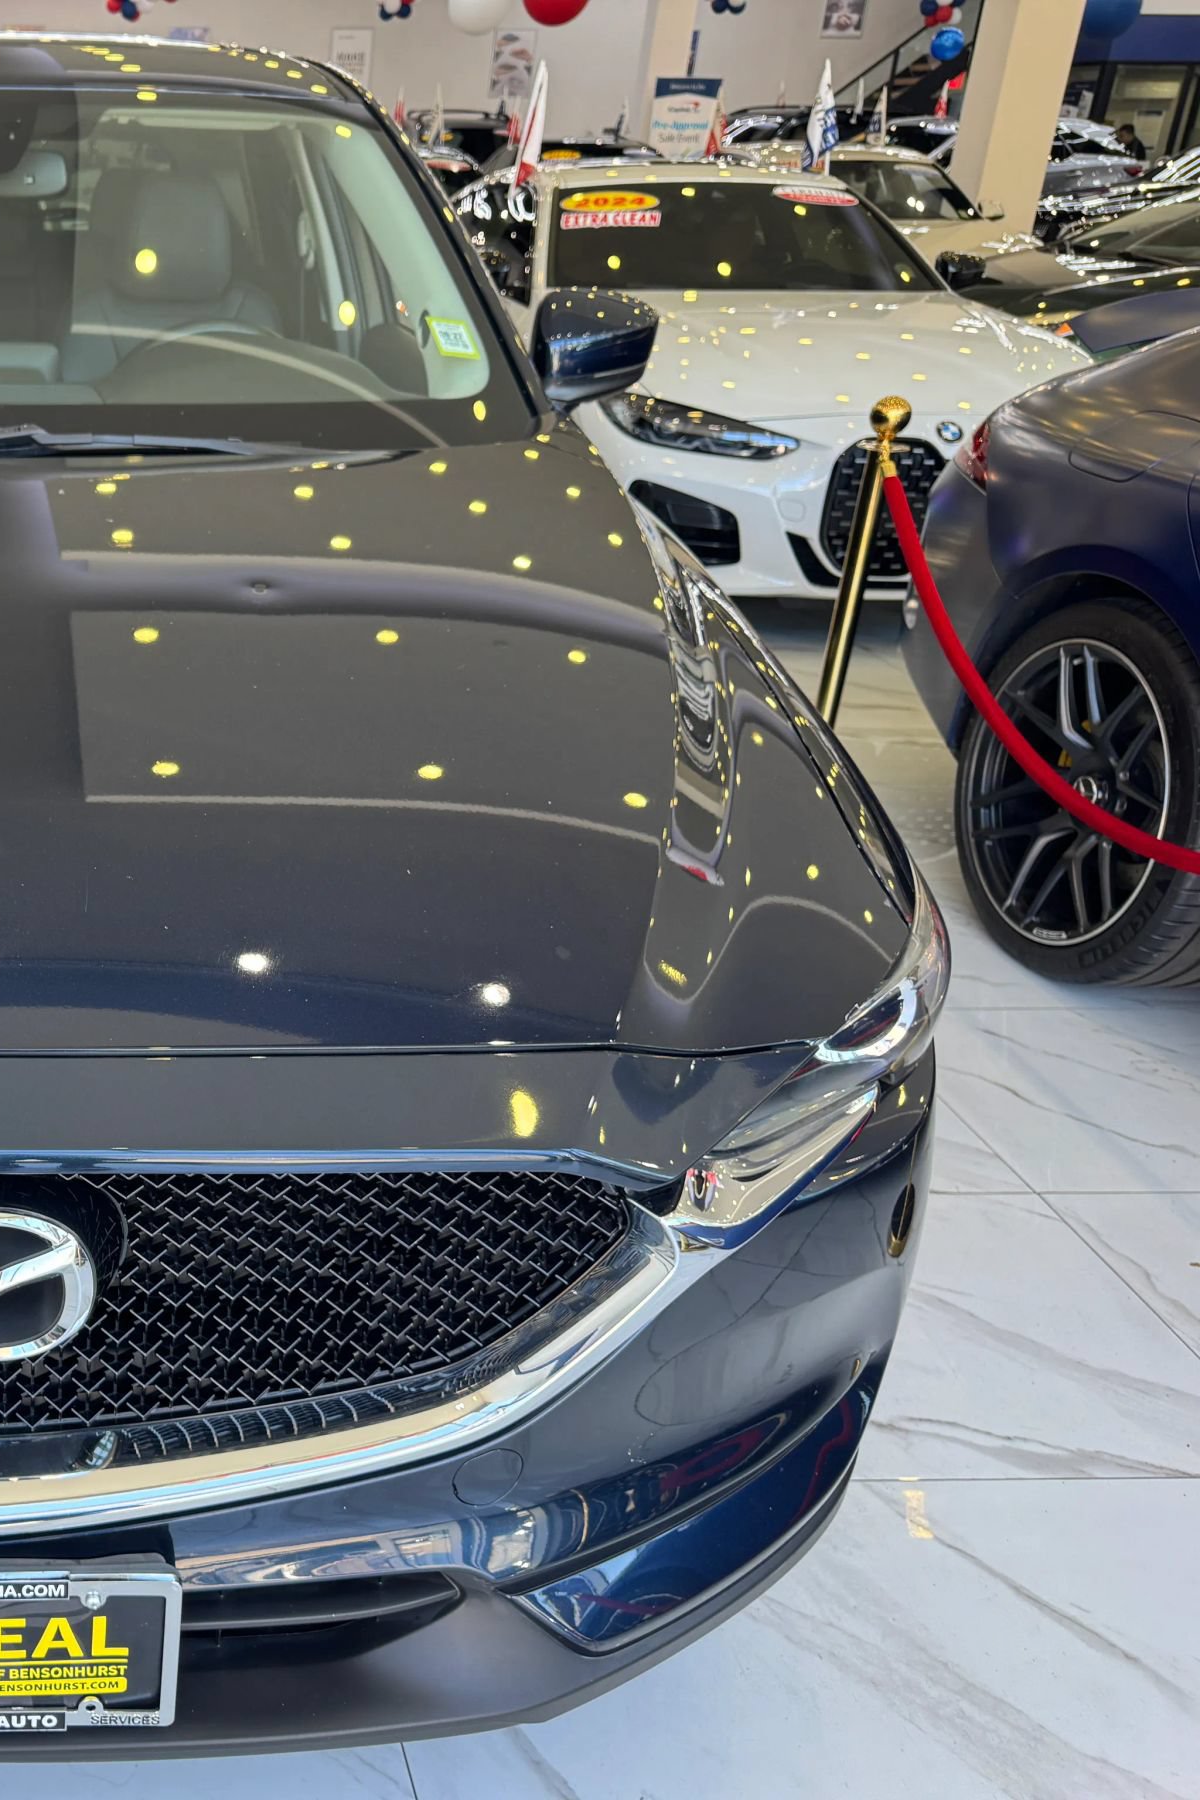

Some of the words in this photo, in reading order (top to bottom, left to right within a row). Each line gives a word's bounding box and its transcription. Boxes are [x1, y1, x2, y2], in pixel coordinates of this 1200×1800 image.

[574, 196, 646, 208] 2024
[563, 211, 608, 228] EXTRA
[613, 210, 659, 226] CLEAN
[9, 1665, 128, 1680] BENSONHURST
[90, 1711, 161, 1726] SERVICES
